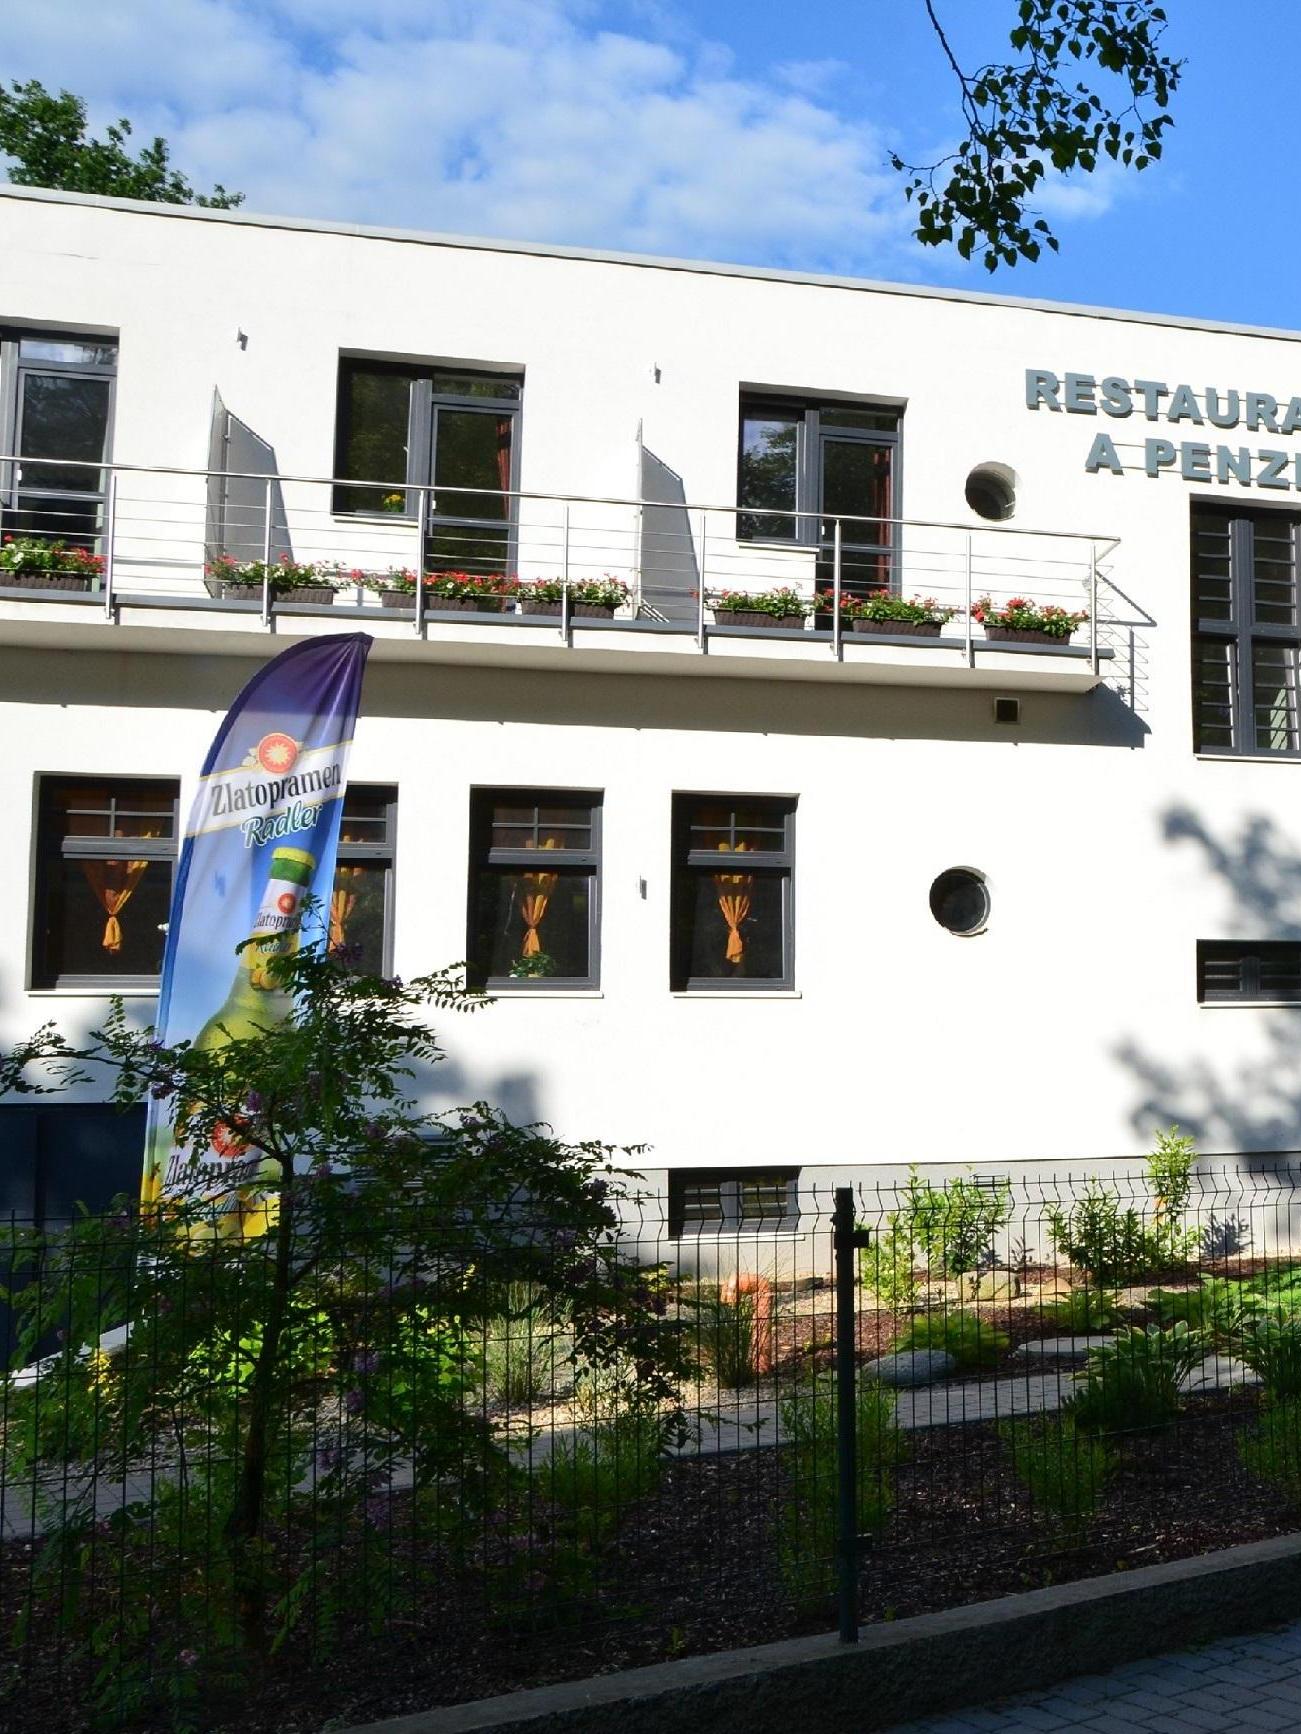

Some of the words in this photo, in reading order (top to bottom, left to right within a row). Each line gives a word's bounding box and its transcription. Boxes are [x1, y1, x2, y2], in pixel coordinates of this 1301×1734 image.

[1085, 433, 1124, 475] A
[211, 763, 341, 817] Zlatopramen
[241, 800, 322, 848] Radler
